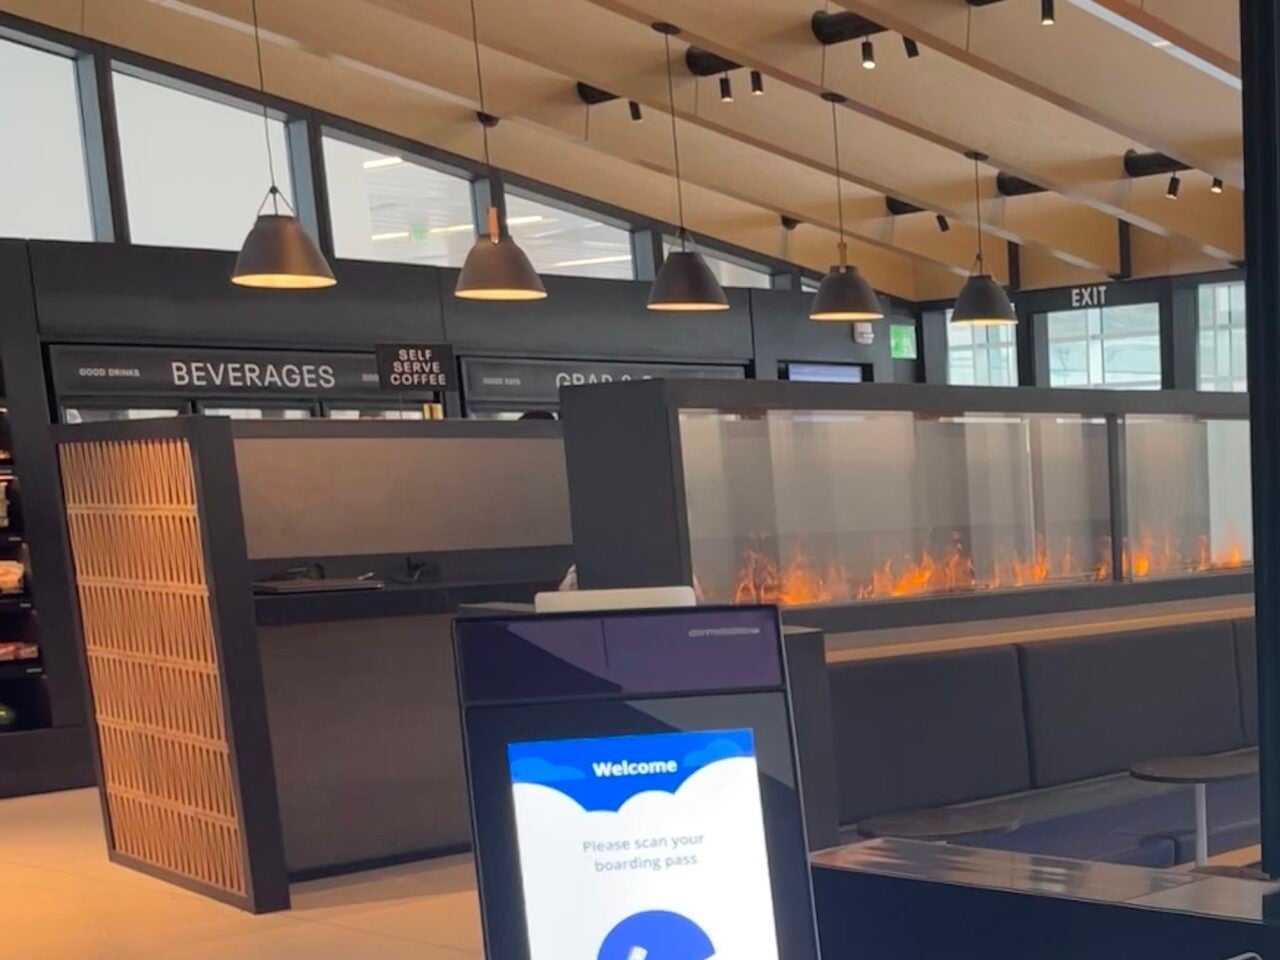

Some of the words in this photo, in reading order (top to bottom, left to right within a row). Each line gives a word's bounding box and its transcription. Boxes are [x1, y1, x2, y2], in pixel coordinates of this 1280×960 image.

[1071, 286, 1107, 307] EXIT
[398, 349, 432, 361] SELF
[171, 361, 337, 389] BEVERAGES
[393, 361, 441, 374] SERVE
[390, 373, 447, 386] COFFEE
[592, 759, 679, 778] Welcome
[582, 840, 631, 853] Please
[634, 836, 669, 849] scan
[671, 834, 706, 850] your
[594, 857, 662, 873] boarding
[664, 855, 698, 869] pass
